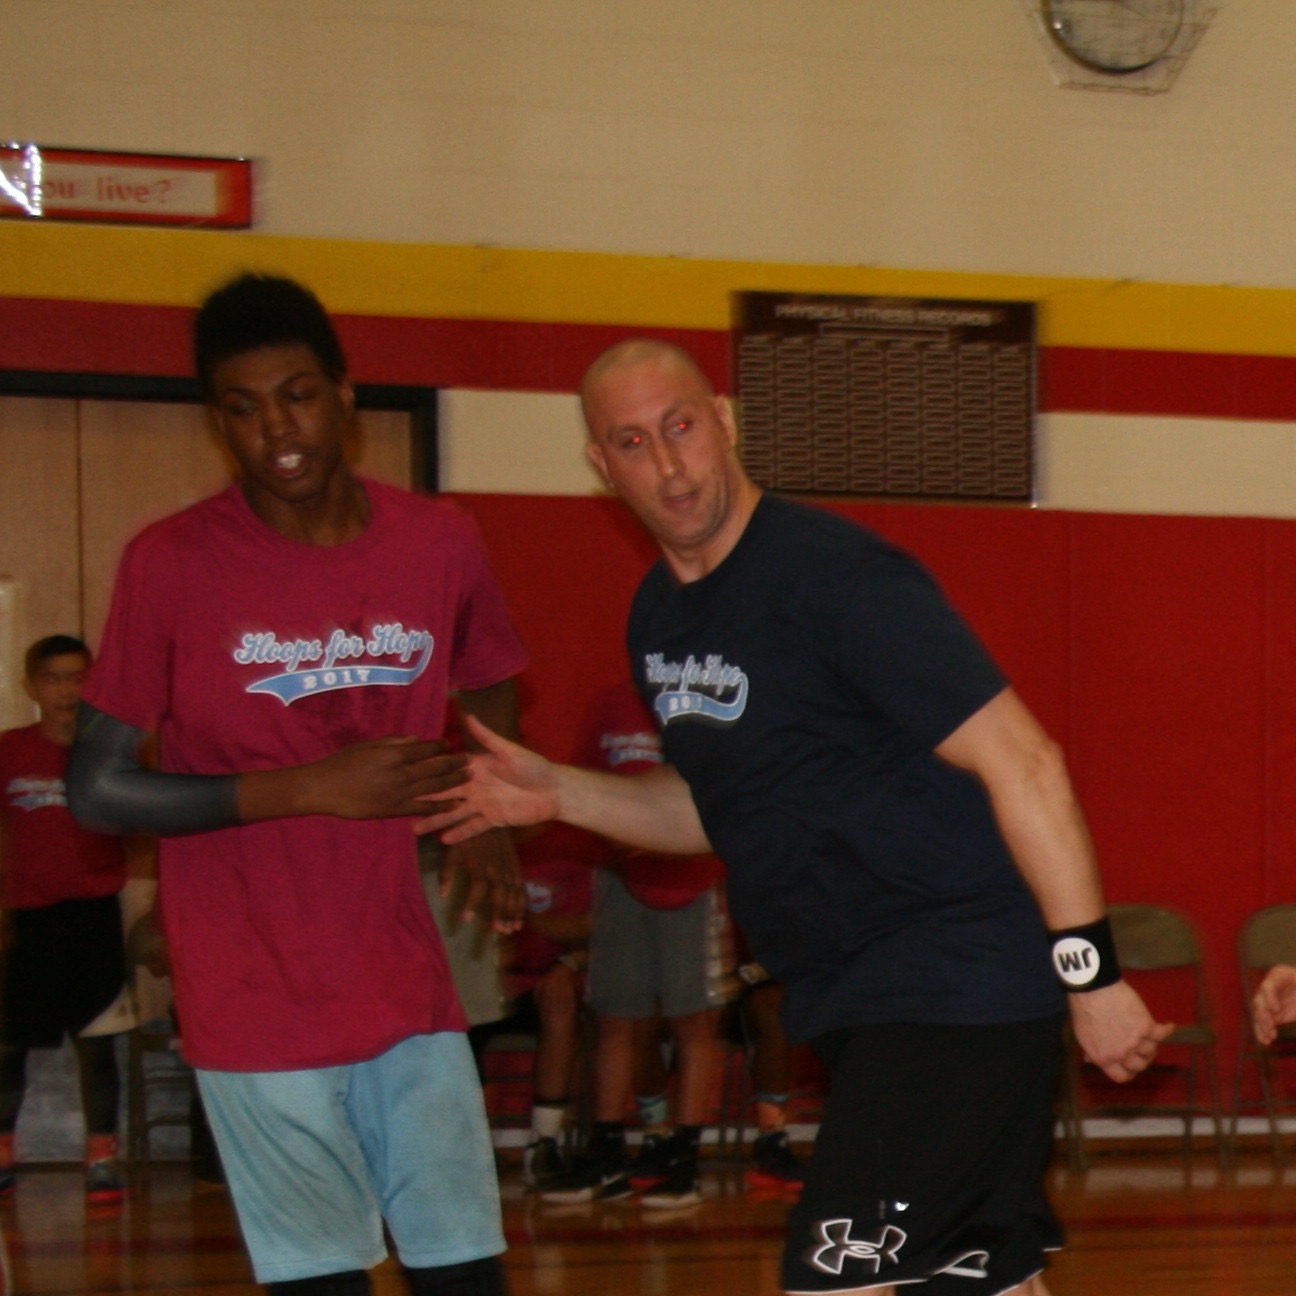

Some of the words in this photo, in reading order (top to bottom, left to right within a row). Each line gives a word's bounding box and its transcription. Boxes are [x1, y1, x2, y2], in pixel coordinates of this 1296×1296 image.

[97, 176, 171, 204] live?
[234, 632, 323, 672] Hoops
[322, 629, 365, 669] for
[303, 669, 370, 690] 2017
[1057, 946, 1093, 974] JM
